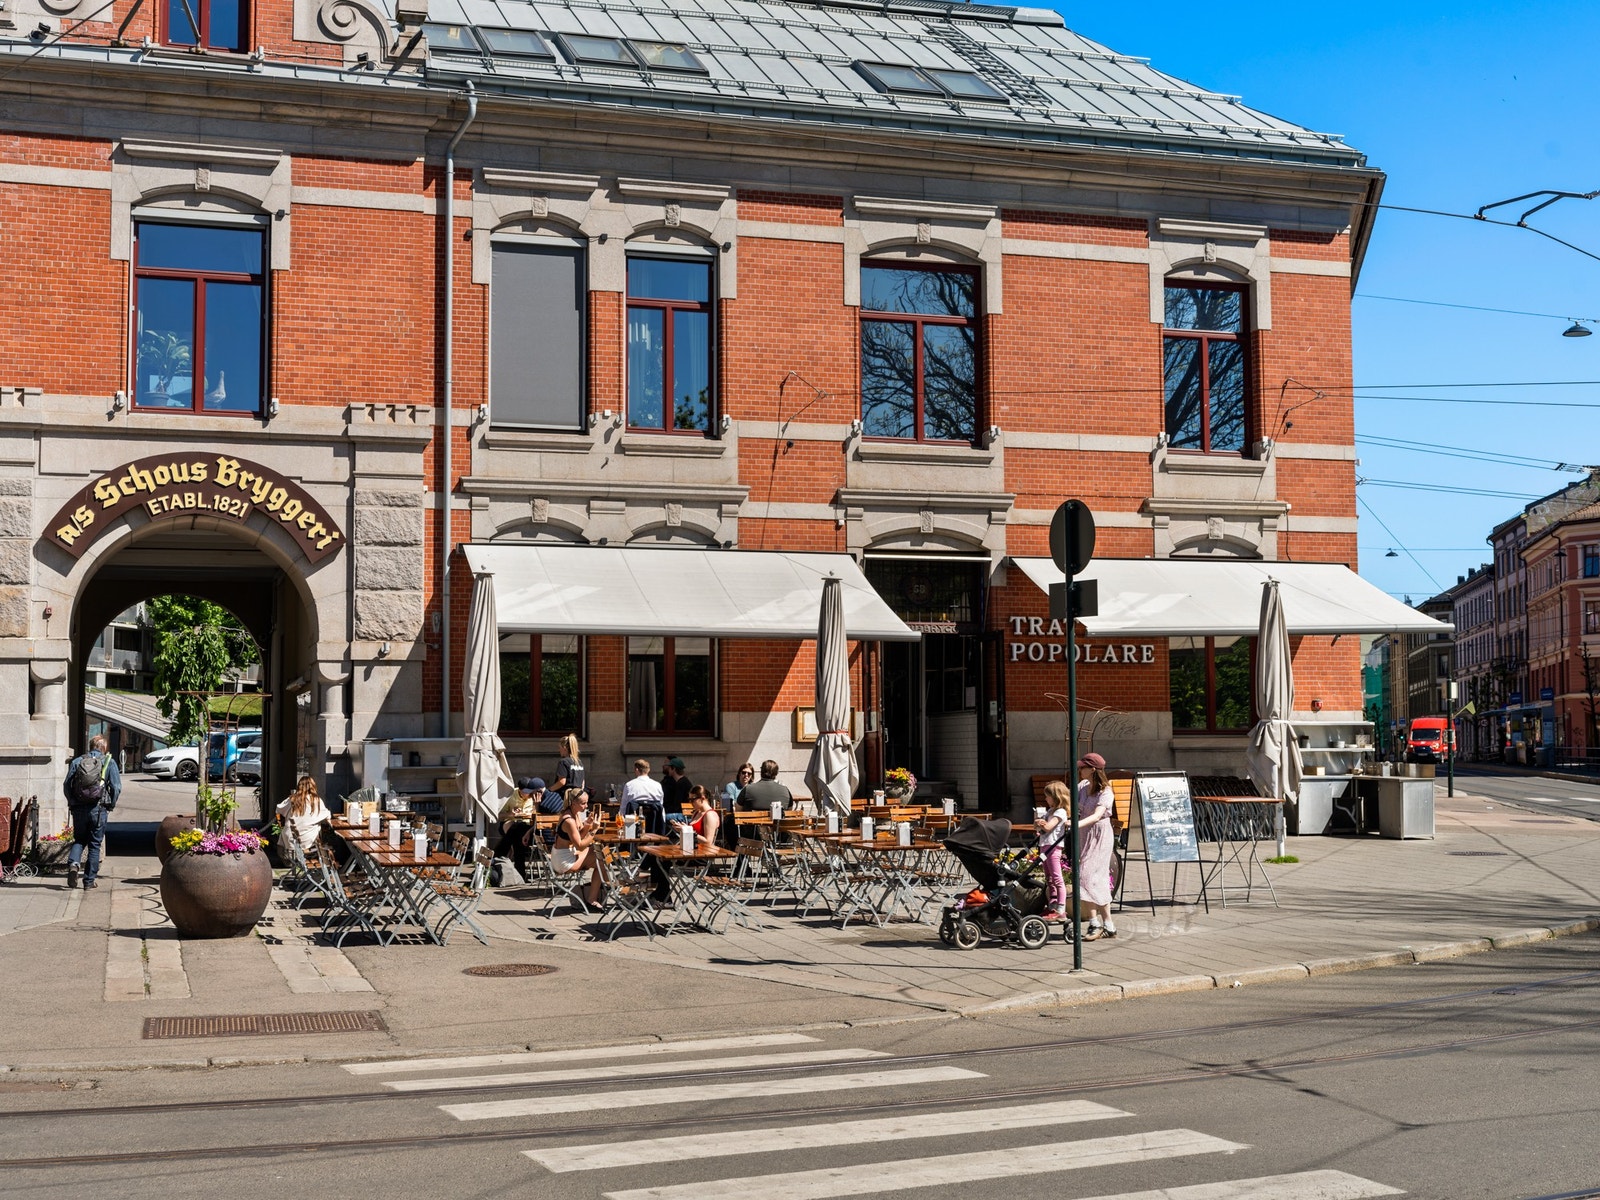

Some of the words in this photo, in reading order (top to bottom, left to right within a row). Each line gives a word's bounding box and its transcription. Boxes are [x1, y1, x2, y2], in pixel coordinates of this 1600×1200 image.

[56, 504, 96, 546] A/S
[93, 463, 209, 508] Schous
[214, 456, 340, 550] Bryggeri
[1010, 642, 1155, 663] POPOLARE
